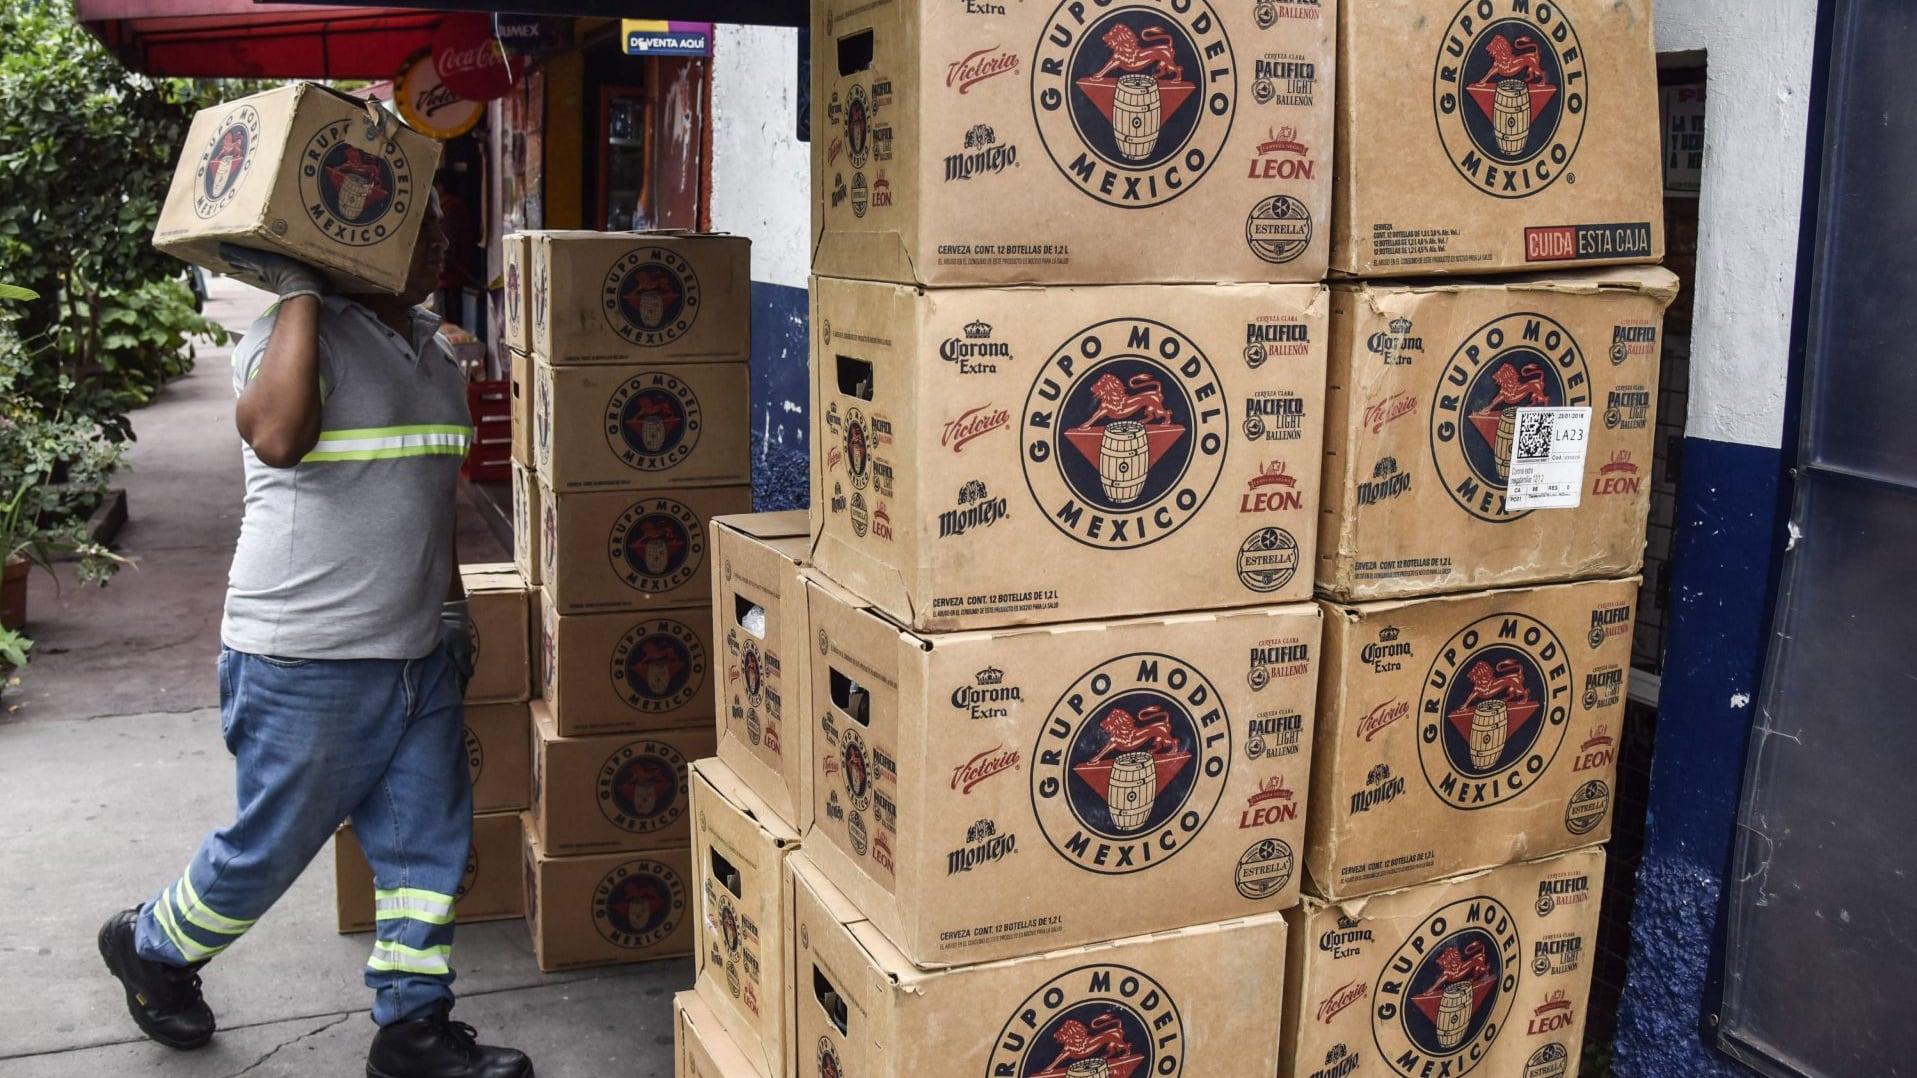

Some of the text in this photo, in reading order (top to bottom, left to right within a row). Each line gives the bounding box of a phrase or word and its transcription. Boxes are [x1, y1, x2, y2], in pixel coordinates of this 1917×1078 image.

[966, 0, 1005, 15] Extra
[646, 37, 678, 48] VENTA
[679, 36, 705, 49] AQUÍ
[946, 43, 1019, 95] Victoria
[1170, 0, 1230, 116] ODELO
[1255, 59, 1315, 80] PACIFICO
[1439, 0, 1582, 114] GRUPO MODELO
[1287, 79, 1313, 94] LIGHT
[1276, 94, 1313, 106] BALLENÓN
[198, 109, 258, 177] GRUPO MODELO
[943, 142, 1017, 183] Montejo
[1069, 148, 1206, 201] MEXICO
[1247, 159, 1314, 179] LEON
[1461, 143, 1567, 192] MEXICO
[385, 141, 409, 214] ODELO
[197, 188, 235, 216] MEXICO
[310, 203, 386, 242] MEXICO
[1255, 224, 1305, 234] ESTRELLA
[938, 245, 1053, 254] CERVEZA CONT. 12 BOTELLAS DE
[1529, 228, 1648, 257] CUIDA ESTA CAJA
[606, 250, 697, 309] GRUPO MODELO
[620, 319, 687, 344] MEXICO
[1247, 323, 1308, 344] PACIFICO
[1613, 325, 1655, 343] PACIFICO
[939, 337, 1009, 363] Corona
[1269, 344, 1308, 356] BALLENÓN
[960, 358, 997, 374] Extra
[1437, 319, 1587, 442] GRUPO MODEL
[608, 375, 698, 435] GRUPO MODELO
[1030, 326, 1221, 463] GRUPO MODELO
[1608, 391, 1650, 408] PACIFICO
[1246, 398, 1303, 417] PACIFICO
[941, 402, 1010, 453] Victoria
[1276, 414, 1301, 428] LIGHT
[1266, 429, 1301, 441] BALLENÓN
[1556, 429, 1584, 441] LA23
[622, 444, 688, 469] MEXICO
[1357, 469, 1411, 506] Montejo
[1592, 477, 1640, 496] LEON
[1240, 491, 1302, 513] LEON
[938, 496, 1007, 539] Montejo
[1056, 488, 1197, 542] MEXICO
[612, 501, 701, 558] GRUPO MODELO
[1245, 554, 1292, 566] ESTRELLA
[1354, 562, 1377, 570] ERVEZA
[1403, 558, 1430, 568] BOTELLAS
[1430, 558, 1438, 566] DE
[626, 566, 691, 590] MEXICO
[933, 597, 964, 608] CERVEZA
[967, 595, 988, 606] CONT.
[989, 595, 997, 604] 12
[998, 592, 1032, 604] BOTELLAS
[1033, 591, 1042, 600] DE
[1590, 606, 1630, 628] PACIFICO
[614, 626, 646, 680] GRUPO
[658, 622, 703, 675] MODELO
[1250, 644, 1308, 668] PACIFICO
[1361, 642, 1411, 665] Corona
[1271, 663, 1308, 678] BALLENÓN
[1374, 661, 1402, 674] Extra
[1586, 668, 1623, 688] PACIFICO
[1423, 618, 1566, 744] GRUPO MODELO
[628, 686, 693, 711] MEXICO
[951, 684, 1021, 711] Corona
[971, 705, 1008, 720] Extra
[1356, 696, 1409, 742] Victoria
[1039, 659, 1223, 799] GRUPO MODELO
[1248, 714, 1302, 738] PACIFICO
[1276, 730, 1299, 746] LIGHT
[1266, 744, 1299, 758] BALLENÓN
[1572, 748, 1616, 772] LEON
[600, 742, 689, 800] GRUPO MODELO
[951, 742, 1020, 795] Victoria
[1439, 754, 1544, 804] MEXICO
[1350, 776, 1405, 816] Montejo
[1571, 801, 1606, 816] ESTRELLA
[614, 807, 680, 832] MEXICO
[1238, 802, 1297, 829] LEON
[1064, 810, 1200, 868] MEXICO
[947, 832, 1016, 877] Montejo
[1341, 865, 1366, 875] CERVEZA
[1390, 854, 1416, 866] BOTELLAS
[1242, 862, 1288, 878] ESTRELLA
[596, 862, 683, 919] GRUPO MODELO
[1538, 876, 1588, 896] PACIFICO
[610, 921, 673, 946] MEXICO
[940, 929, 971, 941] CERVEZA
[974, 926, 994, 936] CONT.
[996, 925, 1002, 933] 12
[1004, 920, 1037, 932] BOTELLAS
[1038, 917, 1048, 926] DE
[1320, 930, 1373, 952] Corona
[1334, 947, 1360, 960] Extra
[1534, 936, 1582, 956] PACIFICO
[1560, 950, 1579, 964] LIGHT
[1378, 902, 1517, 1020] GRUPO MODELO
[1317, 978, 1368, 1024] Victoria
[994, 971, 1177, 1078] RUPO MODELO
[1526, 1010, 1574, 1036] LEON
[1396, 1023, 1496, 1078] MEXICO
